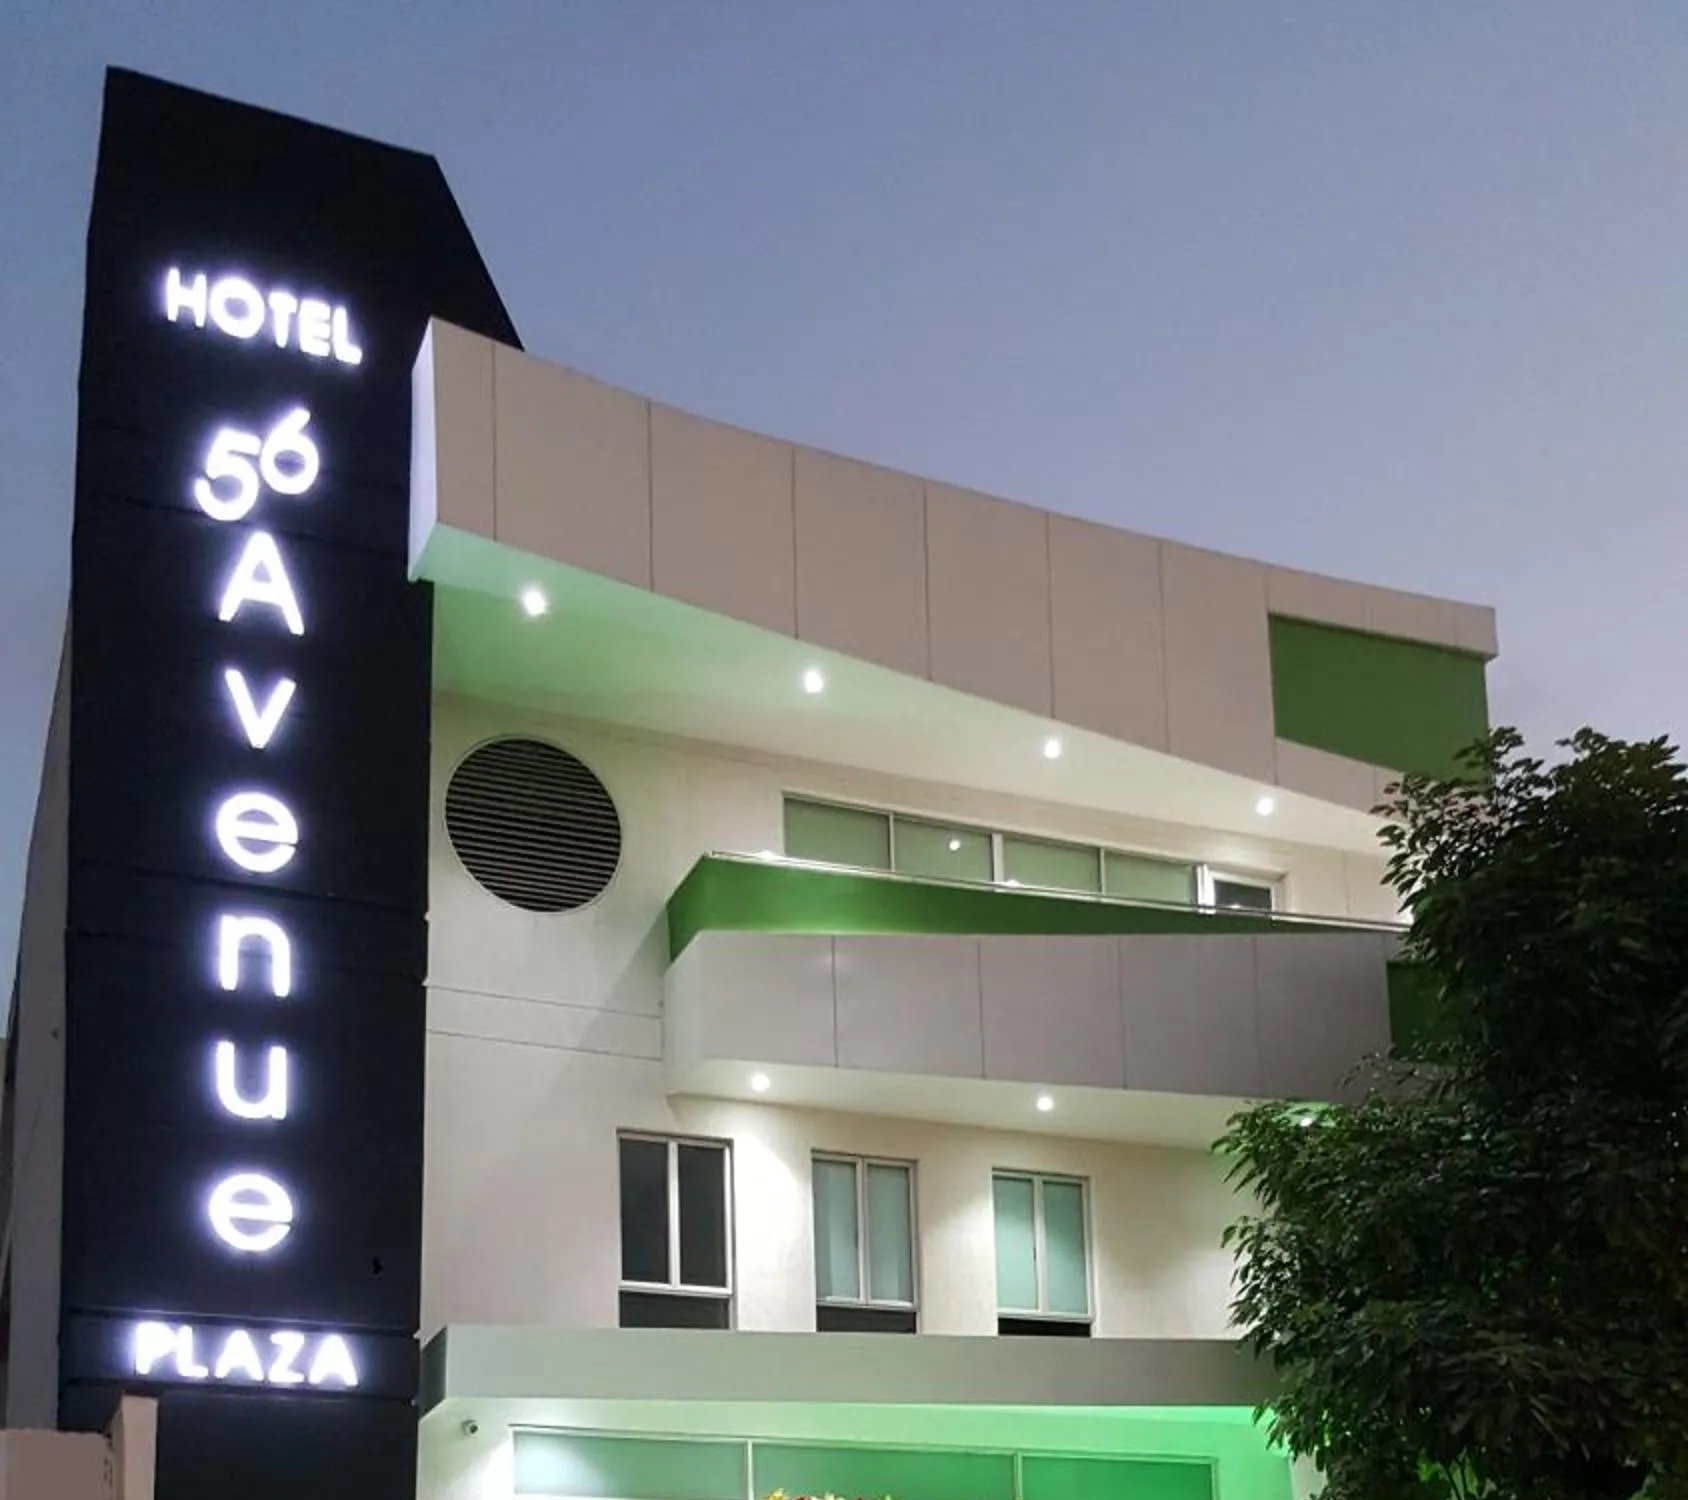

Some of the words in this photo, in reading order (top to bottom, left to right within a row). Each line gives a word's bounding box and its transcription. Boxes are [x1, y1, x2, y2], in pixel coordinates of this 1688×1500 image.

[164, 268, 363, 365] HOTEL
[193, 407, 320, 521] 56
[208, 530, 304, 1252] Avenue
[133, 1320, 358, 1387] PLAZA
